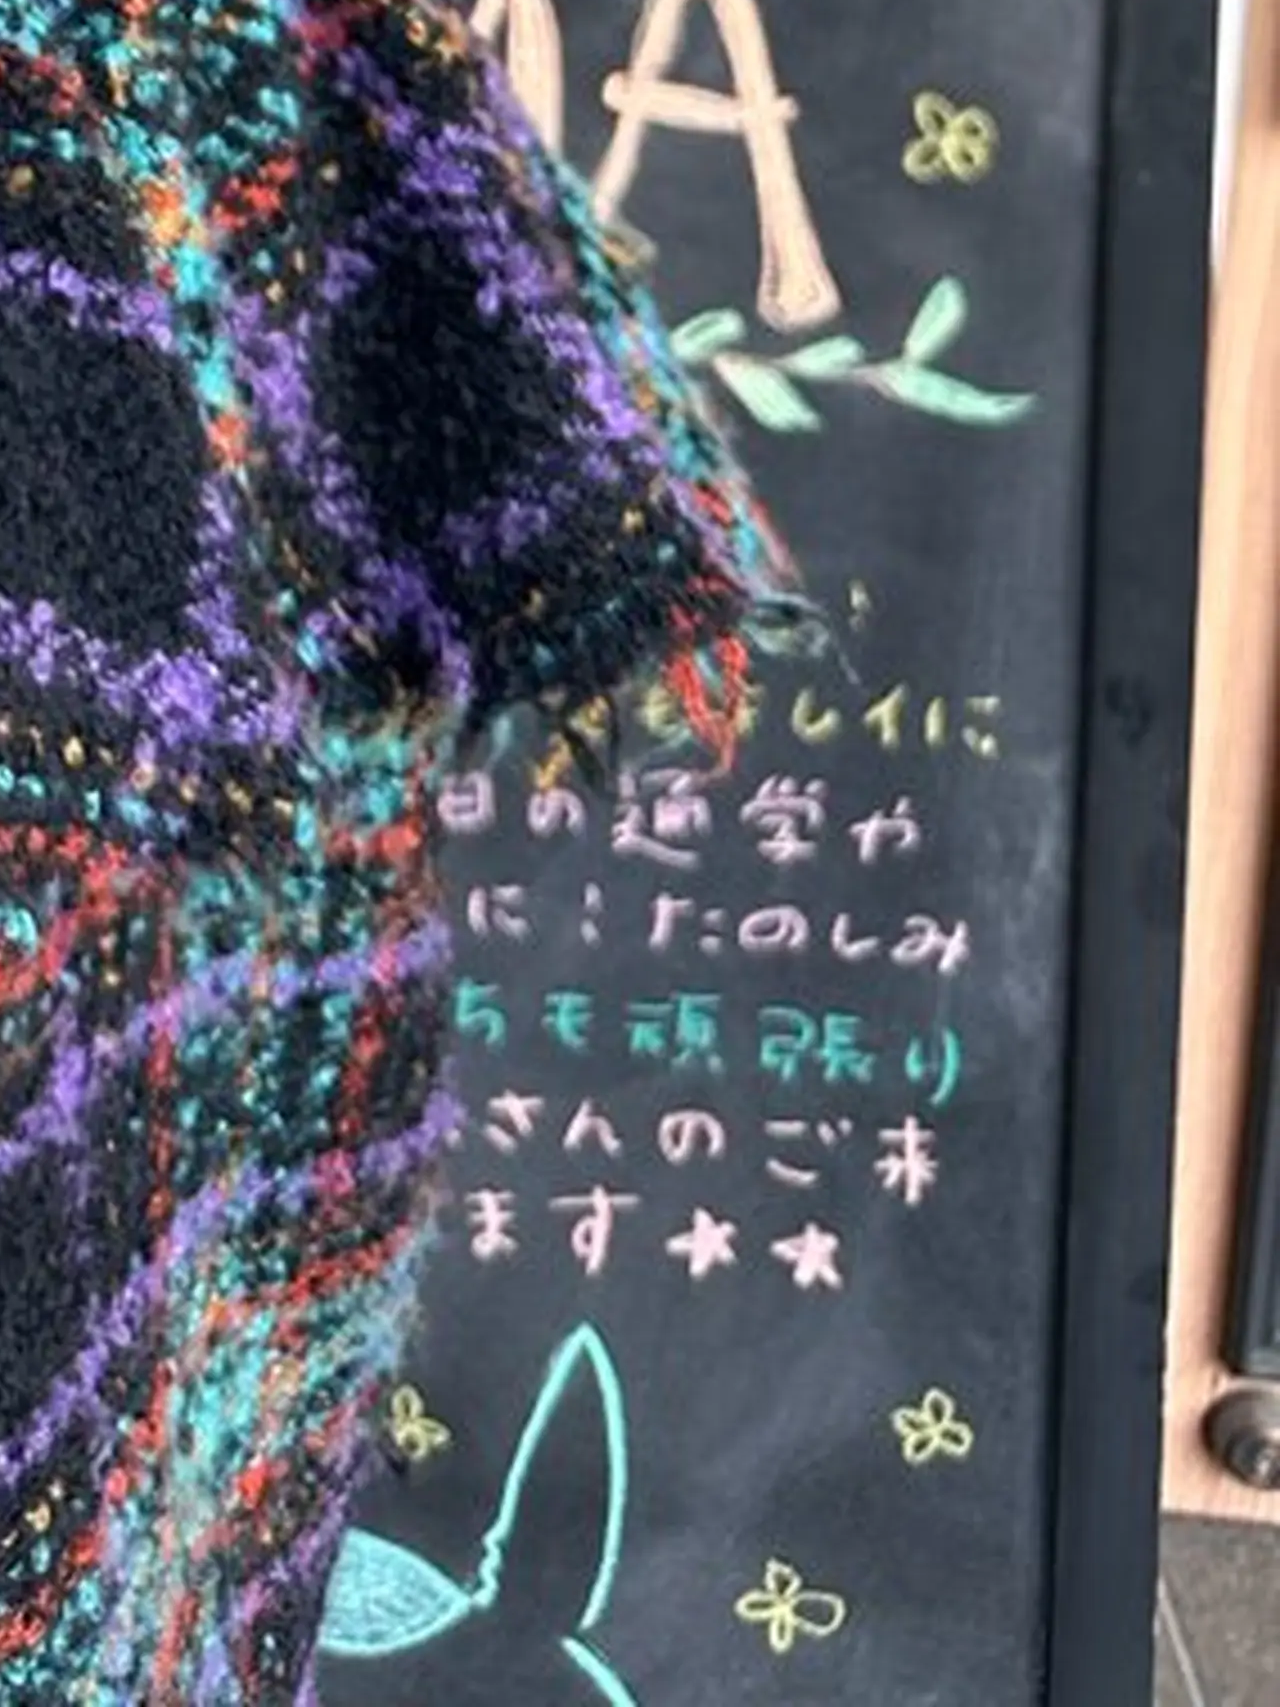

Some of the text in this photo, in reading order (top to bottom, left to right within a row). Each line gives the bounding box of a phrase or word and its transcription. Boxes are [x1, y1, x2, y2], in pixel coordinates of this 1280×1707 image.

[444, 1089, 940, 1206] さんのご来
